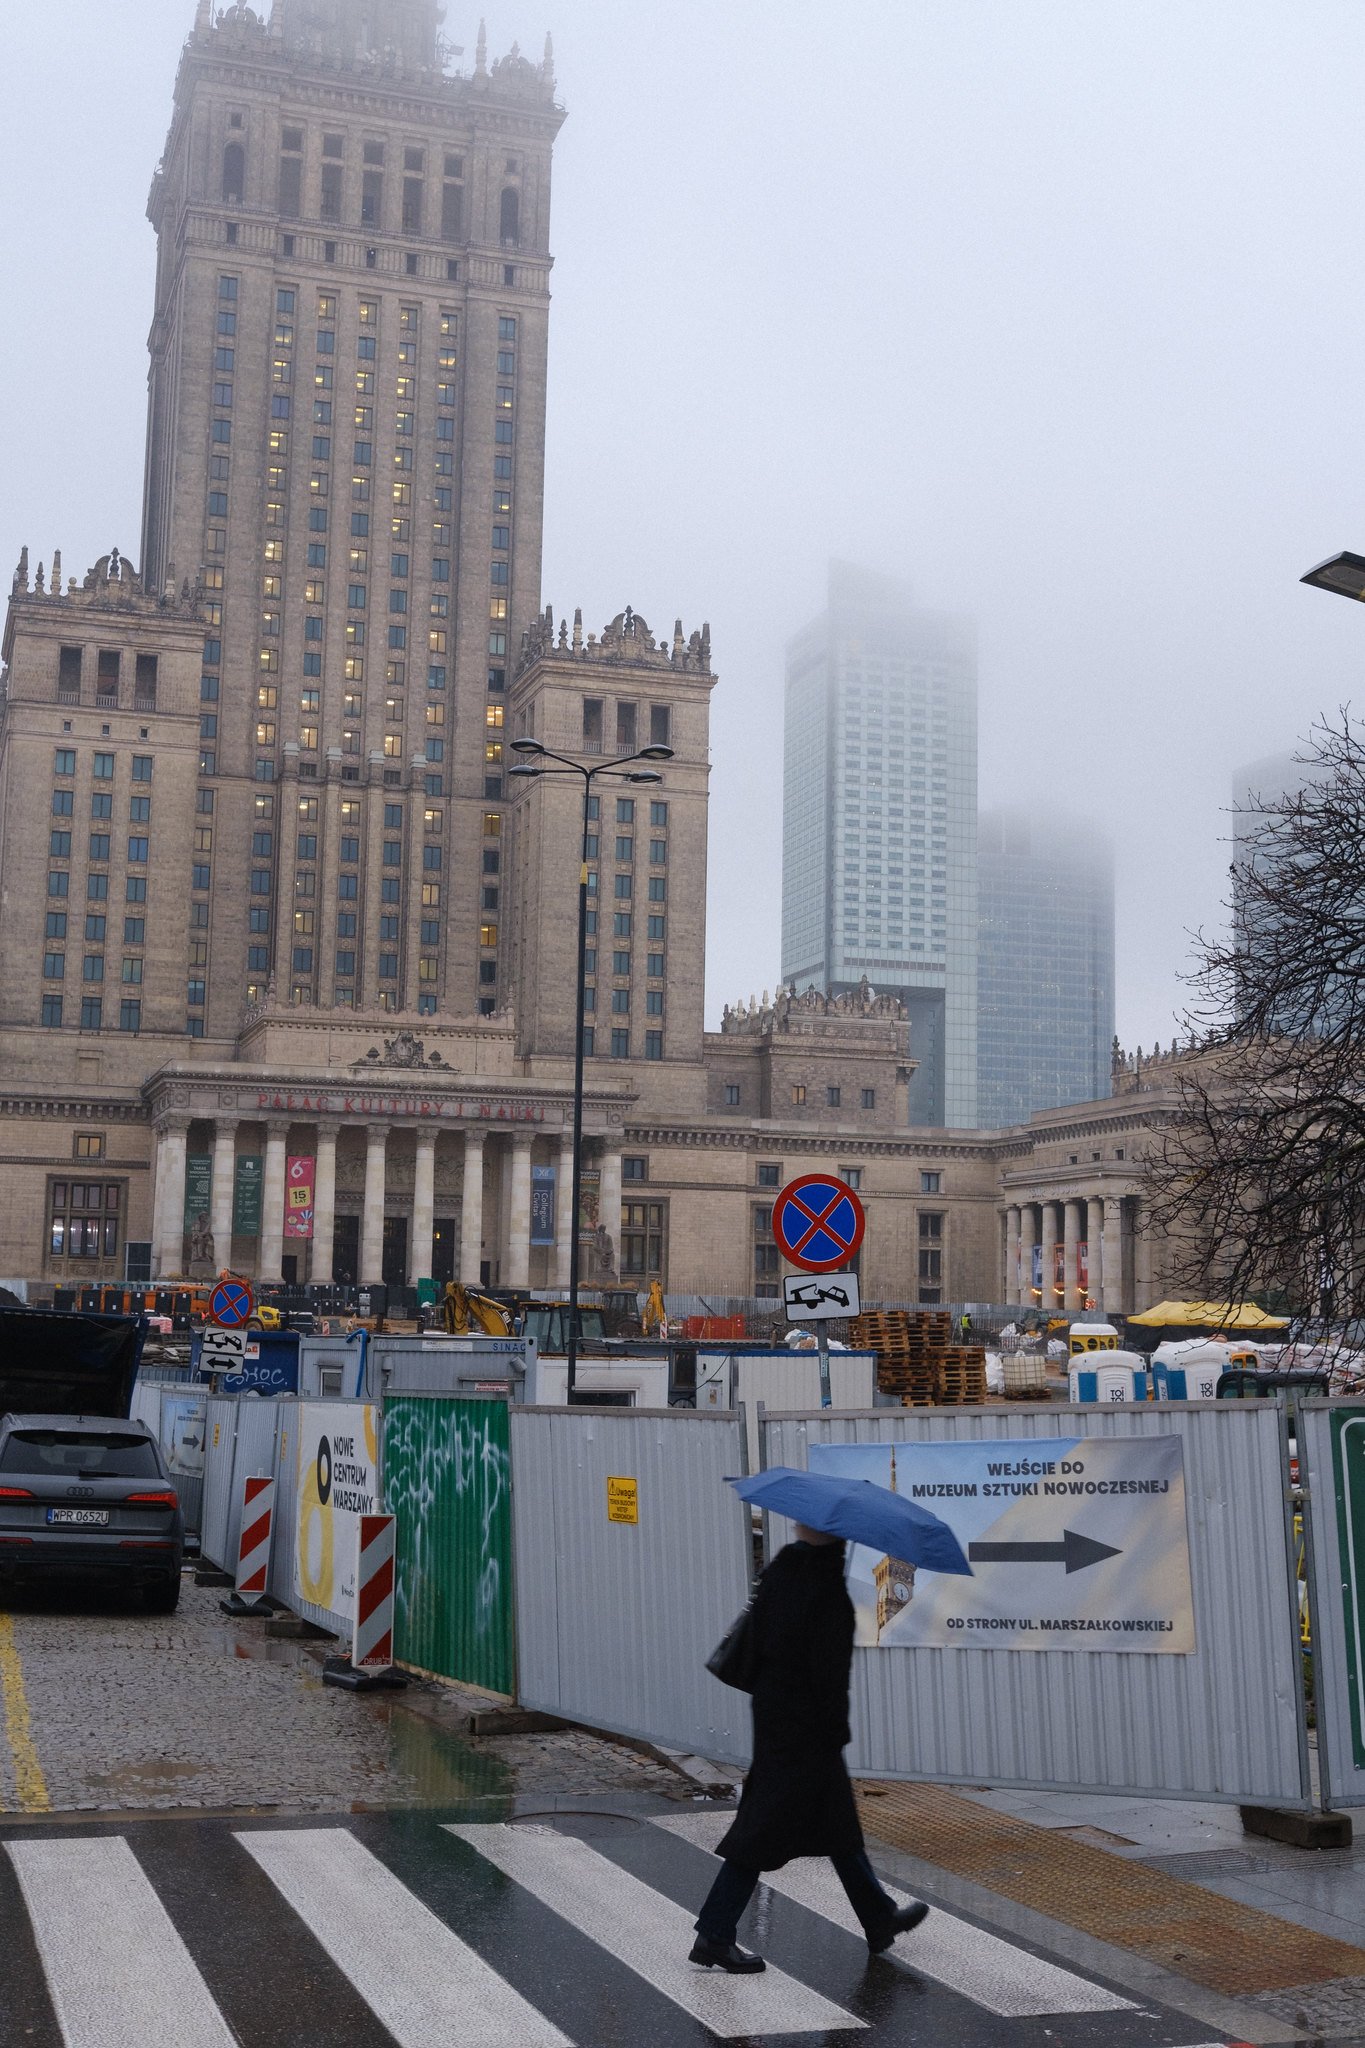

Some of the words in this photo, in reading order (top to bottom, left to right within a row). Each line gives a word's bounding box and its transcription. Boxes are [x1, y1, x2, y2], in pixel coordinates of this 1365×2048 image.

[344, 1097, 445, 1117] KULTURY
[458, 1103, 464, 1117] I
[479, 1103, 546, 1122] NAUKI
[291, 1160, 304, 1178] 6
[293, 1190, 306, 1200] 15
[539, 1193, 549, 1229] Collegium
[333, 1436, 354, 1458] NOWE
[333, 1462, 367, 1487] CENTRUM
[987, 1458, 1056, 1476] WEJŚCIE
[1061, 1461, 1084, 1475] DO
[912, 1484, 978, 1497] MUZEUM
[982, 1483, 1039, 1496] SZTUKI
[1044, 1480, 1169, 1495] NOWOCZESNEJ
[333, 1488, 373, 1515] WARSZAWY
[53, 1510, 74, 1521] WPR
[76, 1511, 108, 1522] 0652U
[946, 1618, 965, 1629] OD
[967, 1618, 1017, 1630] STRONY
[1019, 1619, 1038, 1630] UL.
[1040, 1619, 1173, 1632] MARSZAŁKOWSKIEJ
